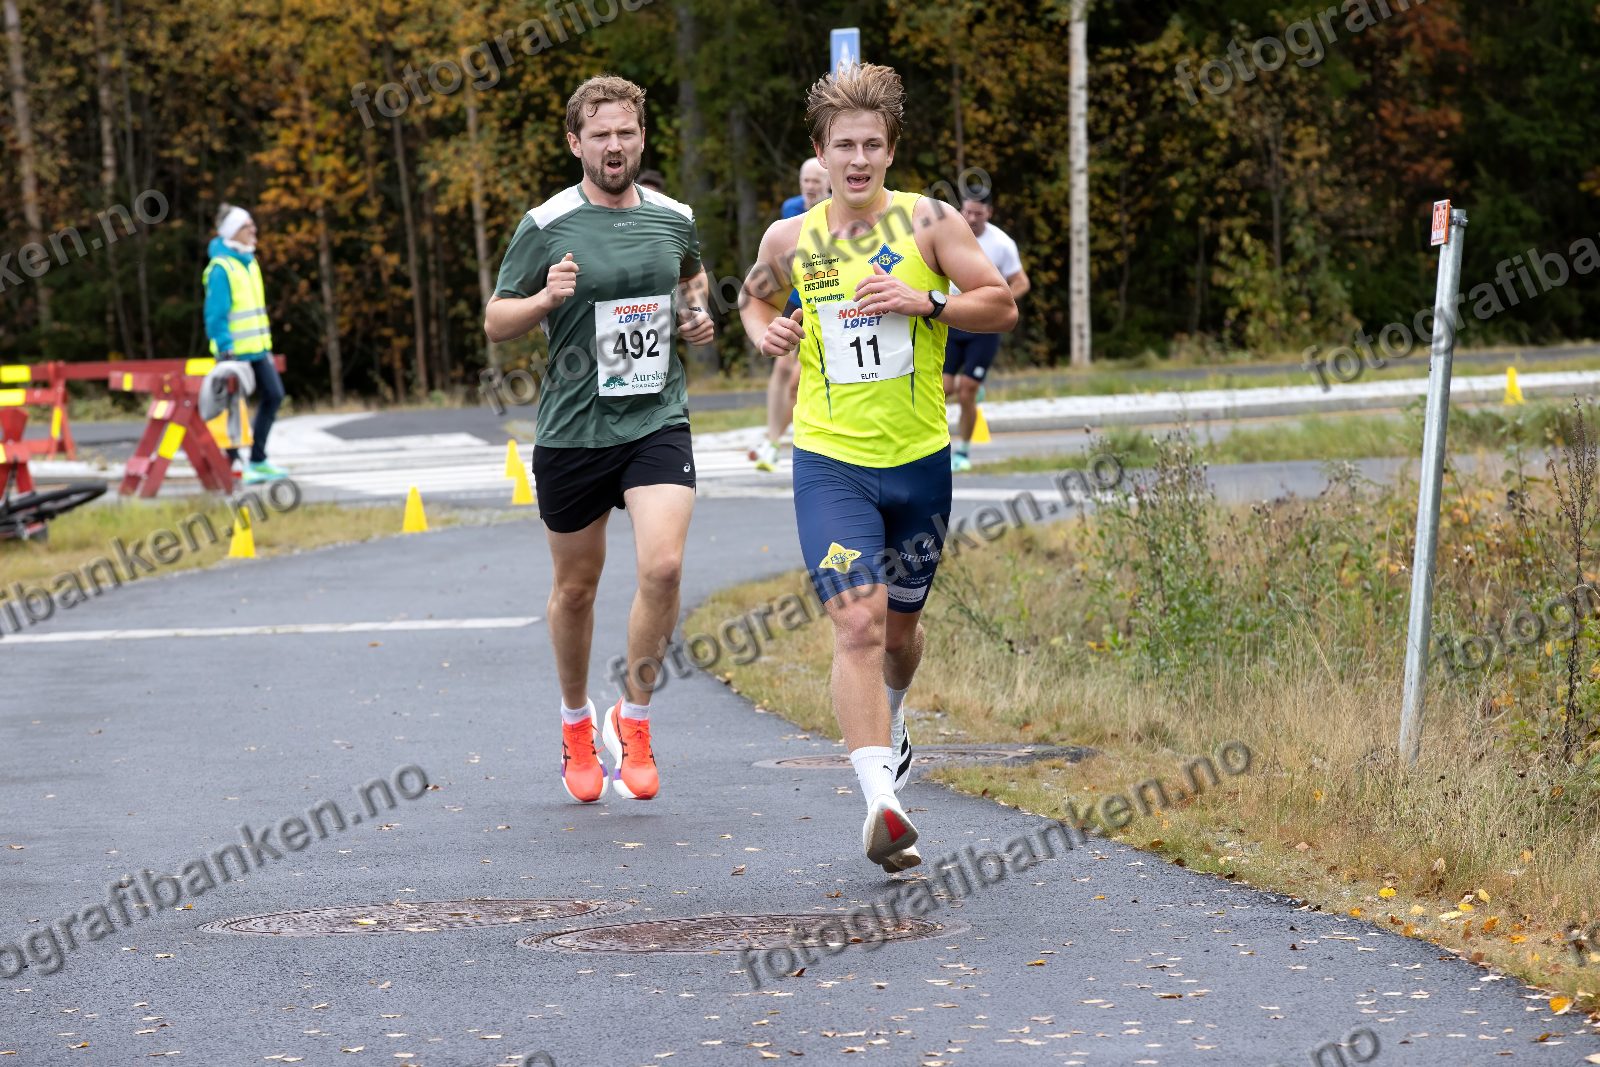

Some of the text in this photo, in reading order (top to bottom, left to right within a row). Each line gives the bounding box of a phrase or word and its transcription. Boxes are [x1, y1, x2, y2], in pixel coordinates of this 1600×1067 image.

[804, 278, 840, 292] EKSJÖHUS
[613, 303, 659, 315] NORGES
[618, 312, 653, 325] LØPET
[844, 316, 882, 330] LØPET
[612, 328, 660, 361] 492
[849, 334, 881, 367] 11
[860, 372, 880, 380] ELITE
